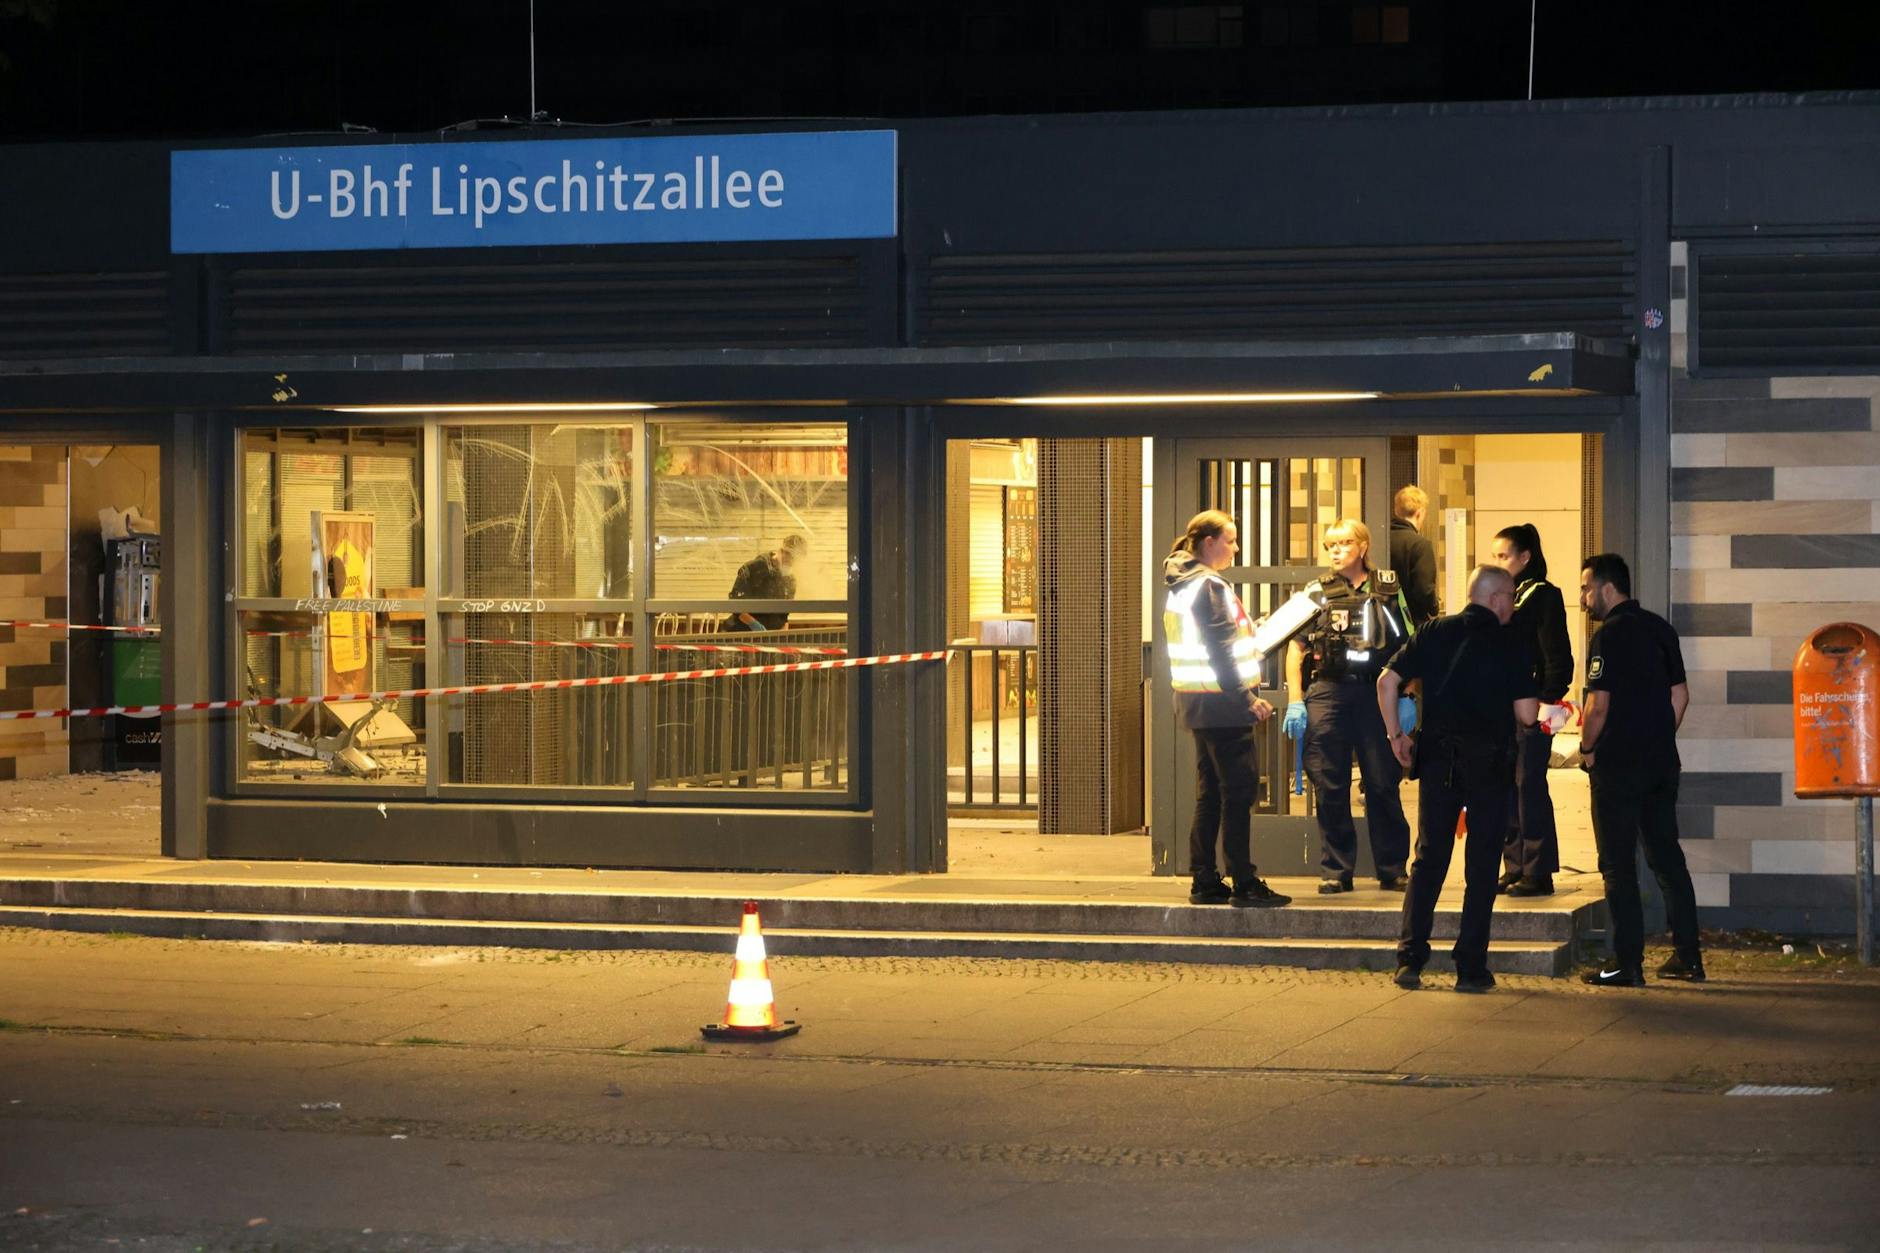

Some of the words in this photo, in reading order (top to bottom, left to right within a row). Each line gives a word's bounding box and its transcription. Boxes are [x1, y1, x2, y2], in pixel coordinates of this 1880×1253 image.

[271, 163, 413, 220] U-Bhf
[432, 155, 785, 229] Lipschitzallee
[295, 599, 333, 611] FREE
[334, 599, 402, 612] PALESTINE
[457, 599, 495, 612] STOP
[1799, 693, 1813, 704] Die
[1800, 705, 1822, 717] bitte!
